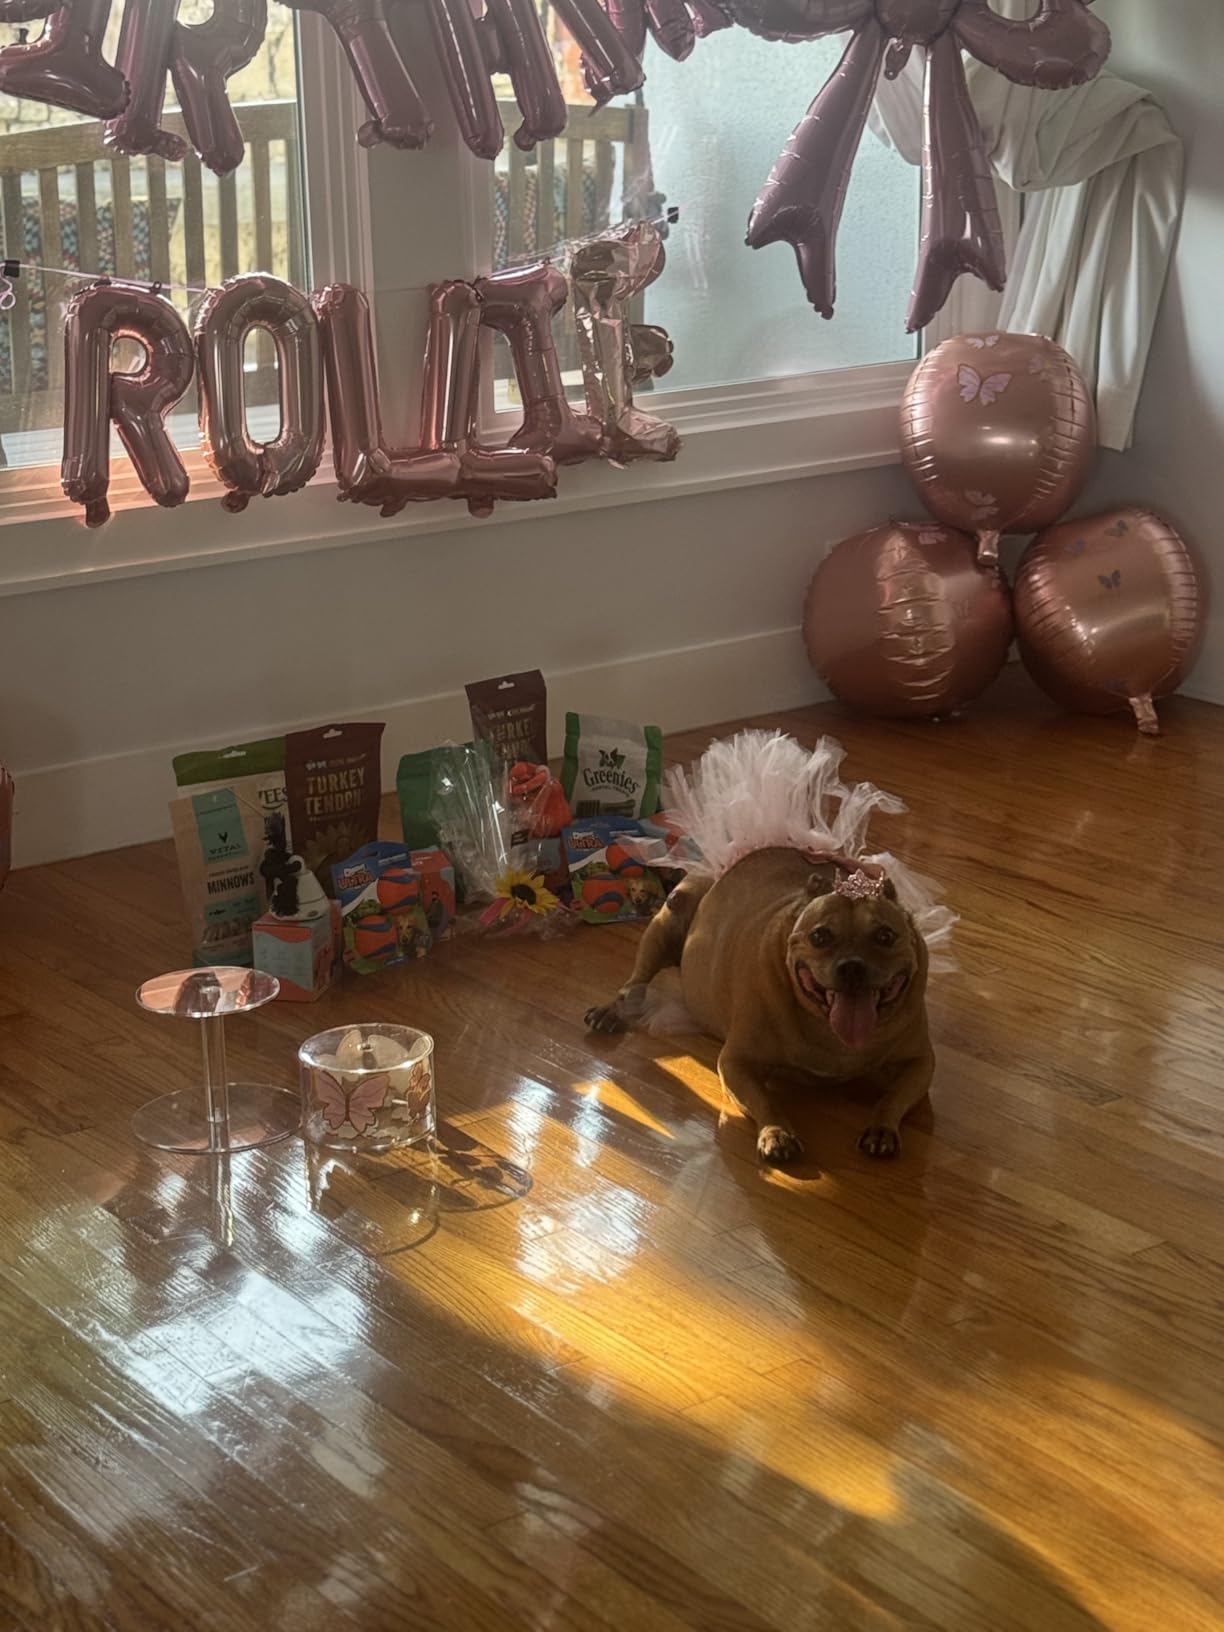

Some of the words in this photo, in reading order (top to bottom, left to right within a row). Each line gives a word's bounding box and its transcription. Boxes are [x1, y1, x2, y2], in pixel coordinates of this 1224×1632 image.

[305, 767, 365, 795] TURKEY
[583, 768, 640, 794] Greenies
[207, 871, 255, 895] MINNOWS
